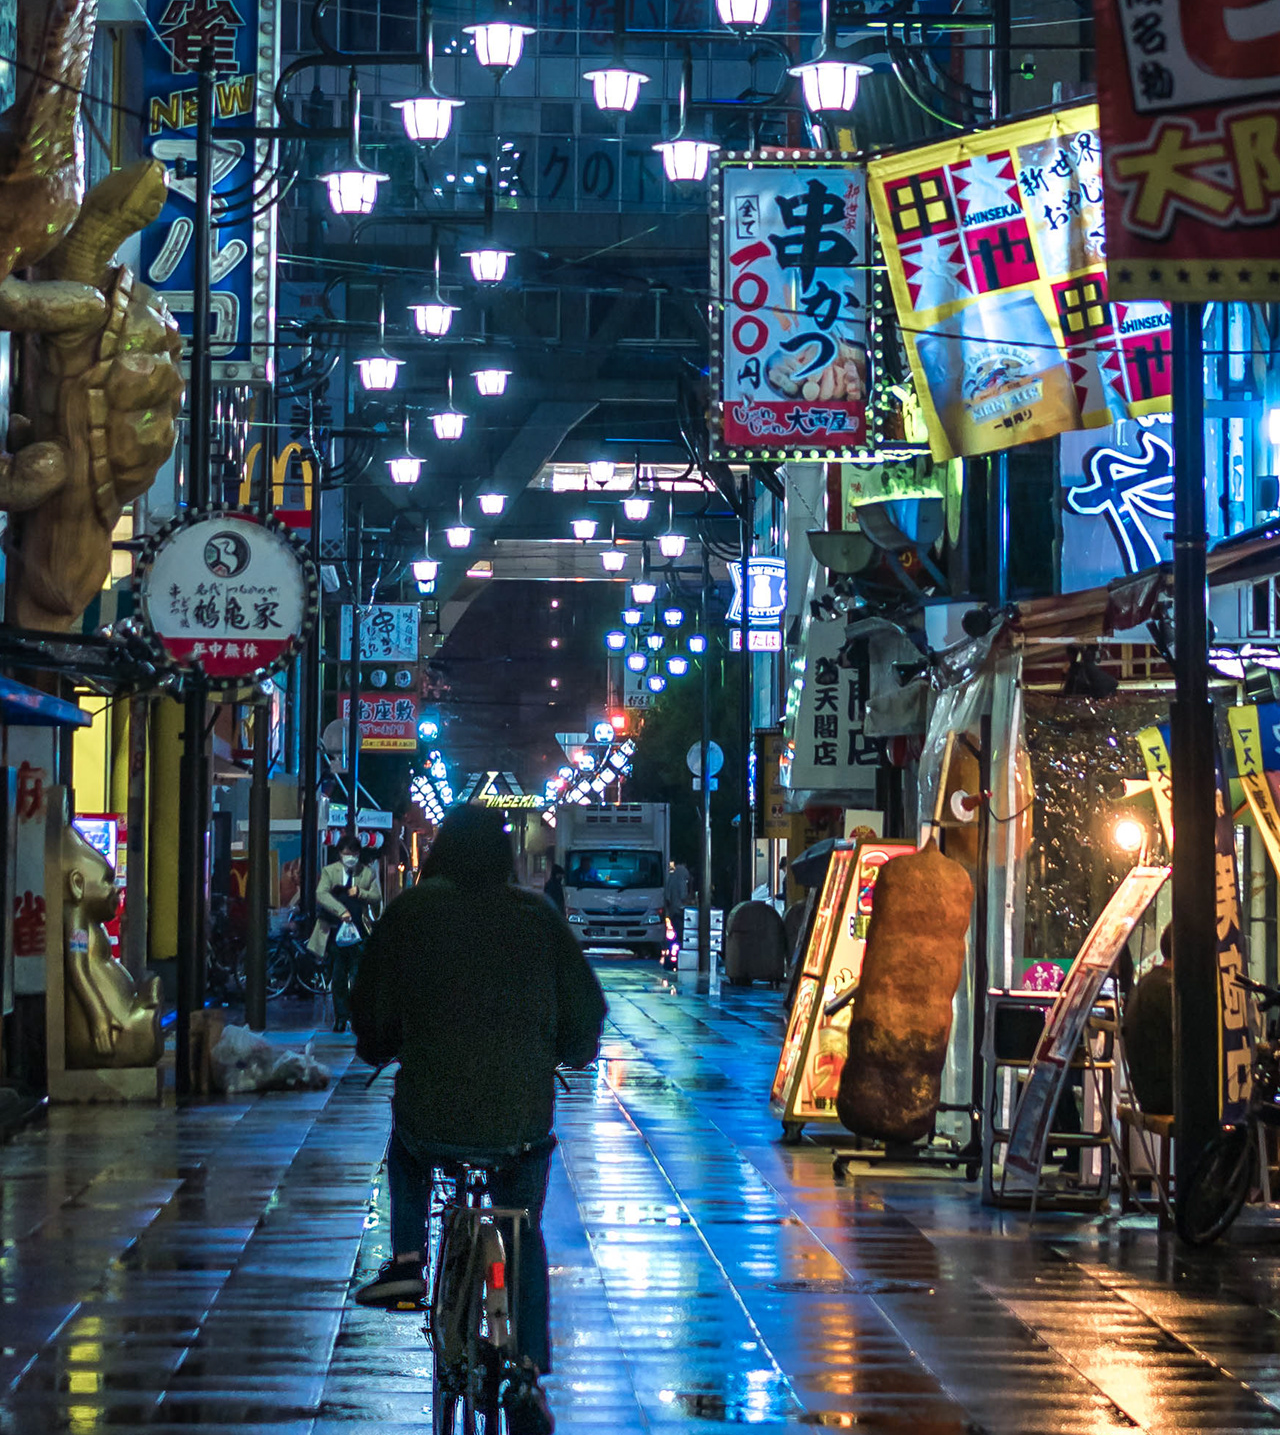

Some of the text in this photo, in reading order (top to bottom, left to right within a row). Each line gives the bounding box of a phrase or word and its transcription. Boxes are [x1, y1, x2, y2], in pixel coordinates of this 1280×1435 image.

[148, 72, 256, 136] NEW
[768, 178, 860, 378] 串かつ
[193, 641, 259, 659] 年中無休
